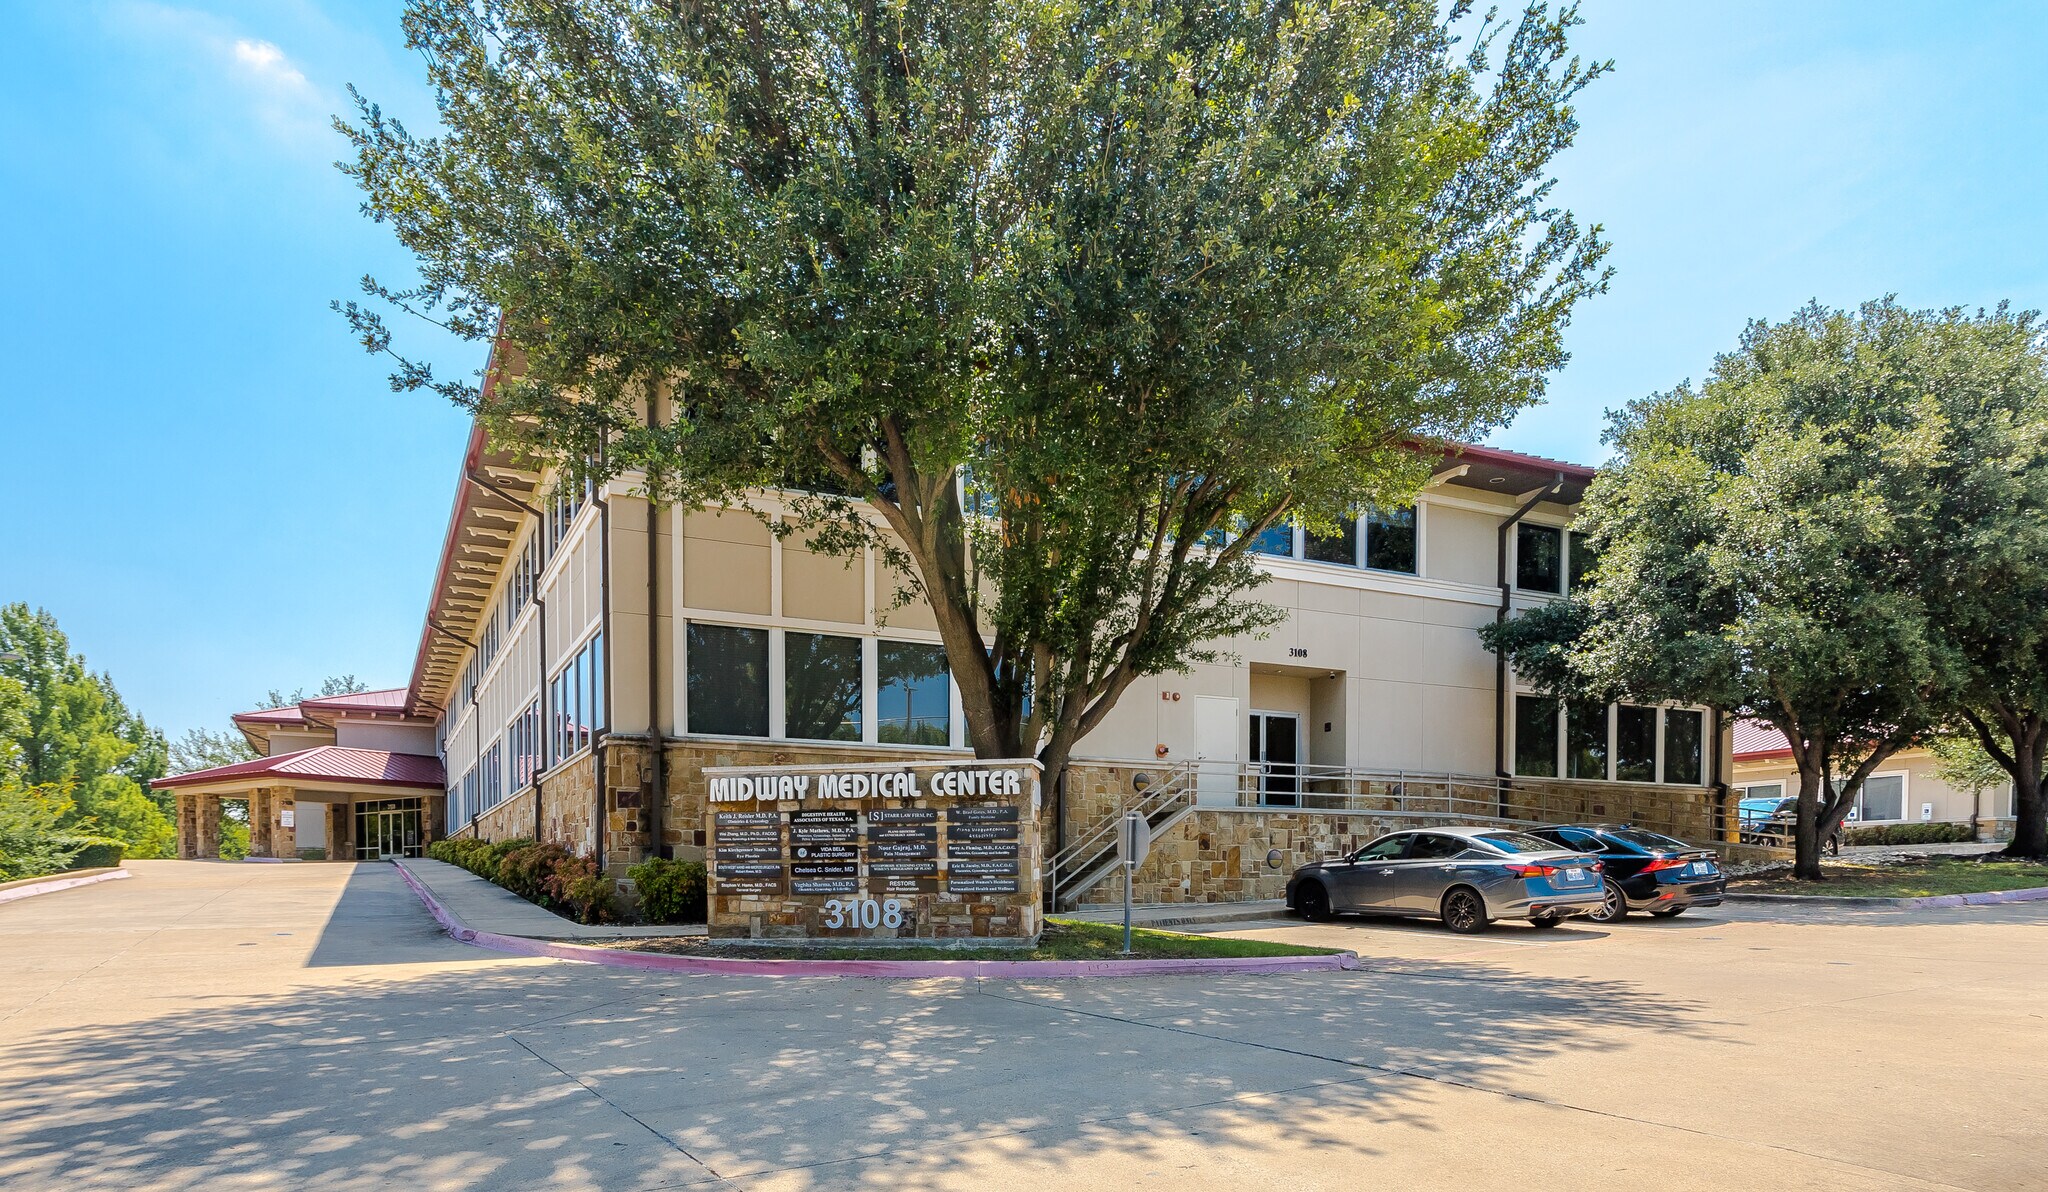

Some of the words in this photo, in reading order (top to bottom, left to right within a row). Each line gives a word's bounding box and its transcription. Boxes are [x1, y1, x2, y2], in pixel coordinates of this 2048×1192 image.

[1289, 648, 1308, 658] 3108
[709, 776, 809, 802] MIDWAY
[818, 772, 923, 798] MEDICAL
[931, 770, 1020, 797] CENTER
[825, 899, 902, 929] 3108
